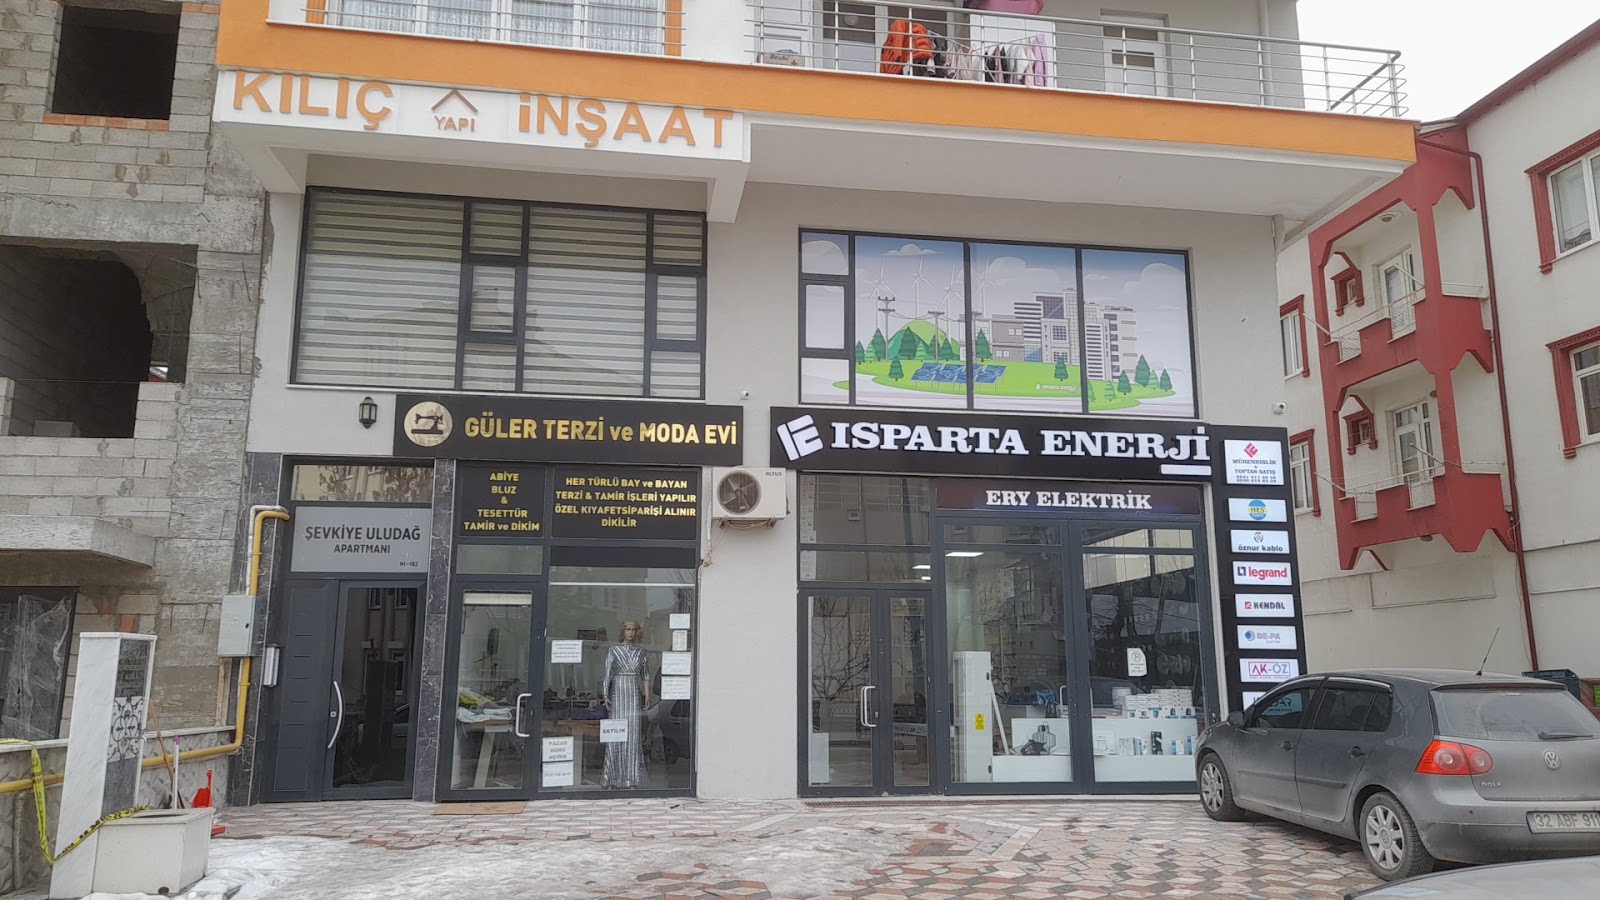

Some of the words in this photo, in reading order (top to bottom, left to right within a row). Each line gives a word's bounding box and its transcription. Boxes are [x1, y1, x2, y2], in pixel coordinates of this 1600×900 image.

[233, 71, 394, 131] KILIÇ
[518, 92, 734, 148] İNŞAAT
[434, 115, 476, 132] YAPI
[464, 411, 537, 439] GÜLER
[542, 416, 604, 441] TERZİ
[609, 425, 633, 442] ve
[639, 421, 700, 445] MODA
[704, 421, 737, 445] EVİ
[830, 421, 1030, 456] ISPARTA
[1040, 426, 1211, 461] ENERJİ
[489, 471, 520, 481] ABİYE
[566, 477, 585, 486] HER
[588, 476, 619, 487] TÜRLÜ
[621, 478, 641, 487] BAY
[655, 480, 688, 489] BAYAN
[491, 485, 517, 494] BLUZ
[500, 496, 508, 504] &
[555, 489, 583, 500] TERZİ
[585, 492, 592, 500] &
[595, 490, 625, 501] TAMİR
[627, 491, 657, 502] İŞLERİ
[659, 493, 697, 503] YAPILIR
[985, 490, 1031, 506] ERY
[1036, 490, 1152, 510] ELEKTRİK
[477, 507, 528, 518] TESETTÜR
[555, 503, 579, 514] ÖZEL
[664, 507, 696, 516] ALINIR
[464, 520, 495, 531] TAMİR
[511, 520, 540, 531] DİKİM
[601, 517, 637, 527] DİKİLİR
[305, 524, 363, 541] ŞEVKİYE
[366, 525, 421, 541] ULUDAĞ
[333, 544, 391, 554] APARTMANI
[1238, 543, 1259, 552] öznur
[1262, 544, 1283, 552] kablo
[1248, 566, 1288, 581] legrand
[1253, 601, 1286, 610] KENDAL
[1256, 632, 1281, 640] DE-PA
[1252, 663, 1288, 675] AK-ÖZ
[1536, 813, 1552, 828] 32
[1557, 813, 1578, 828] ABF
